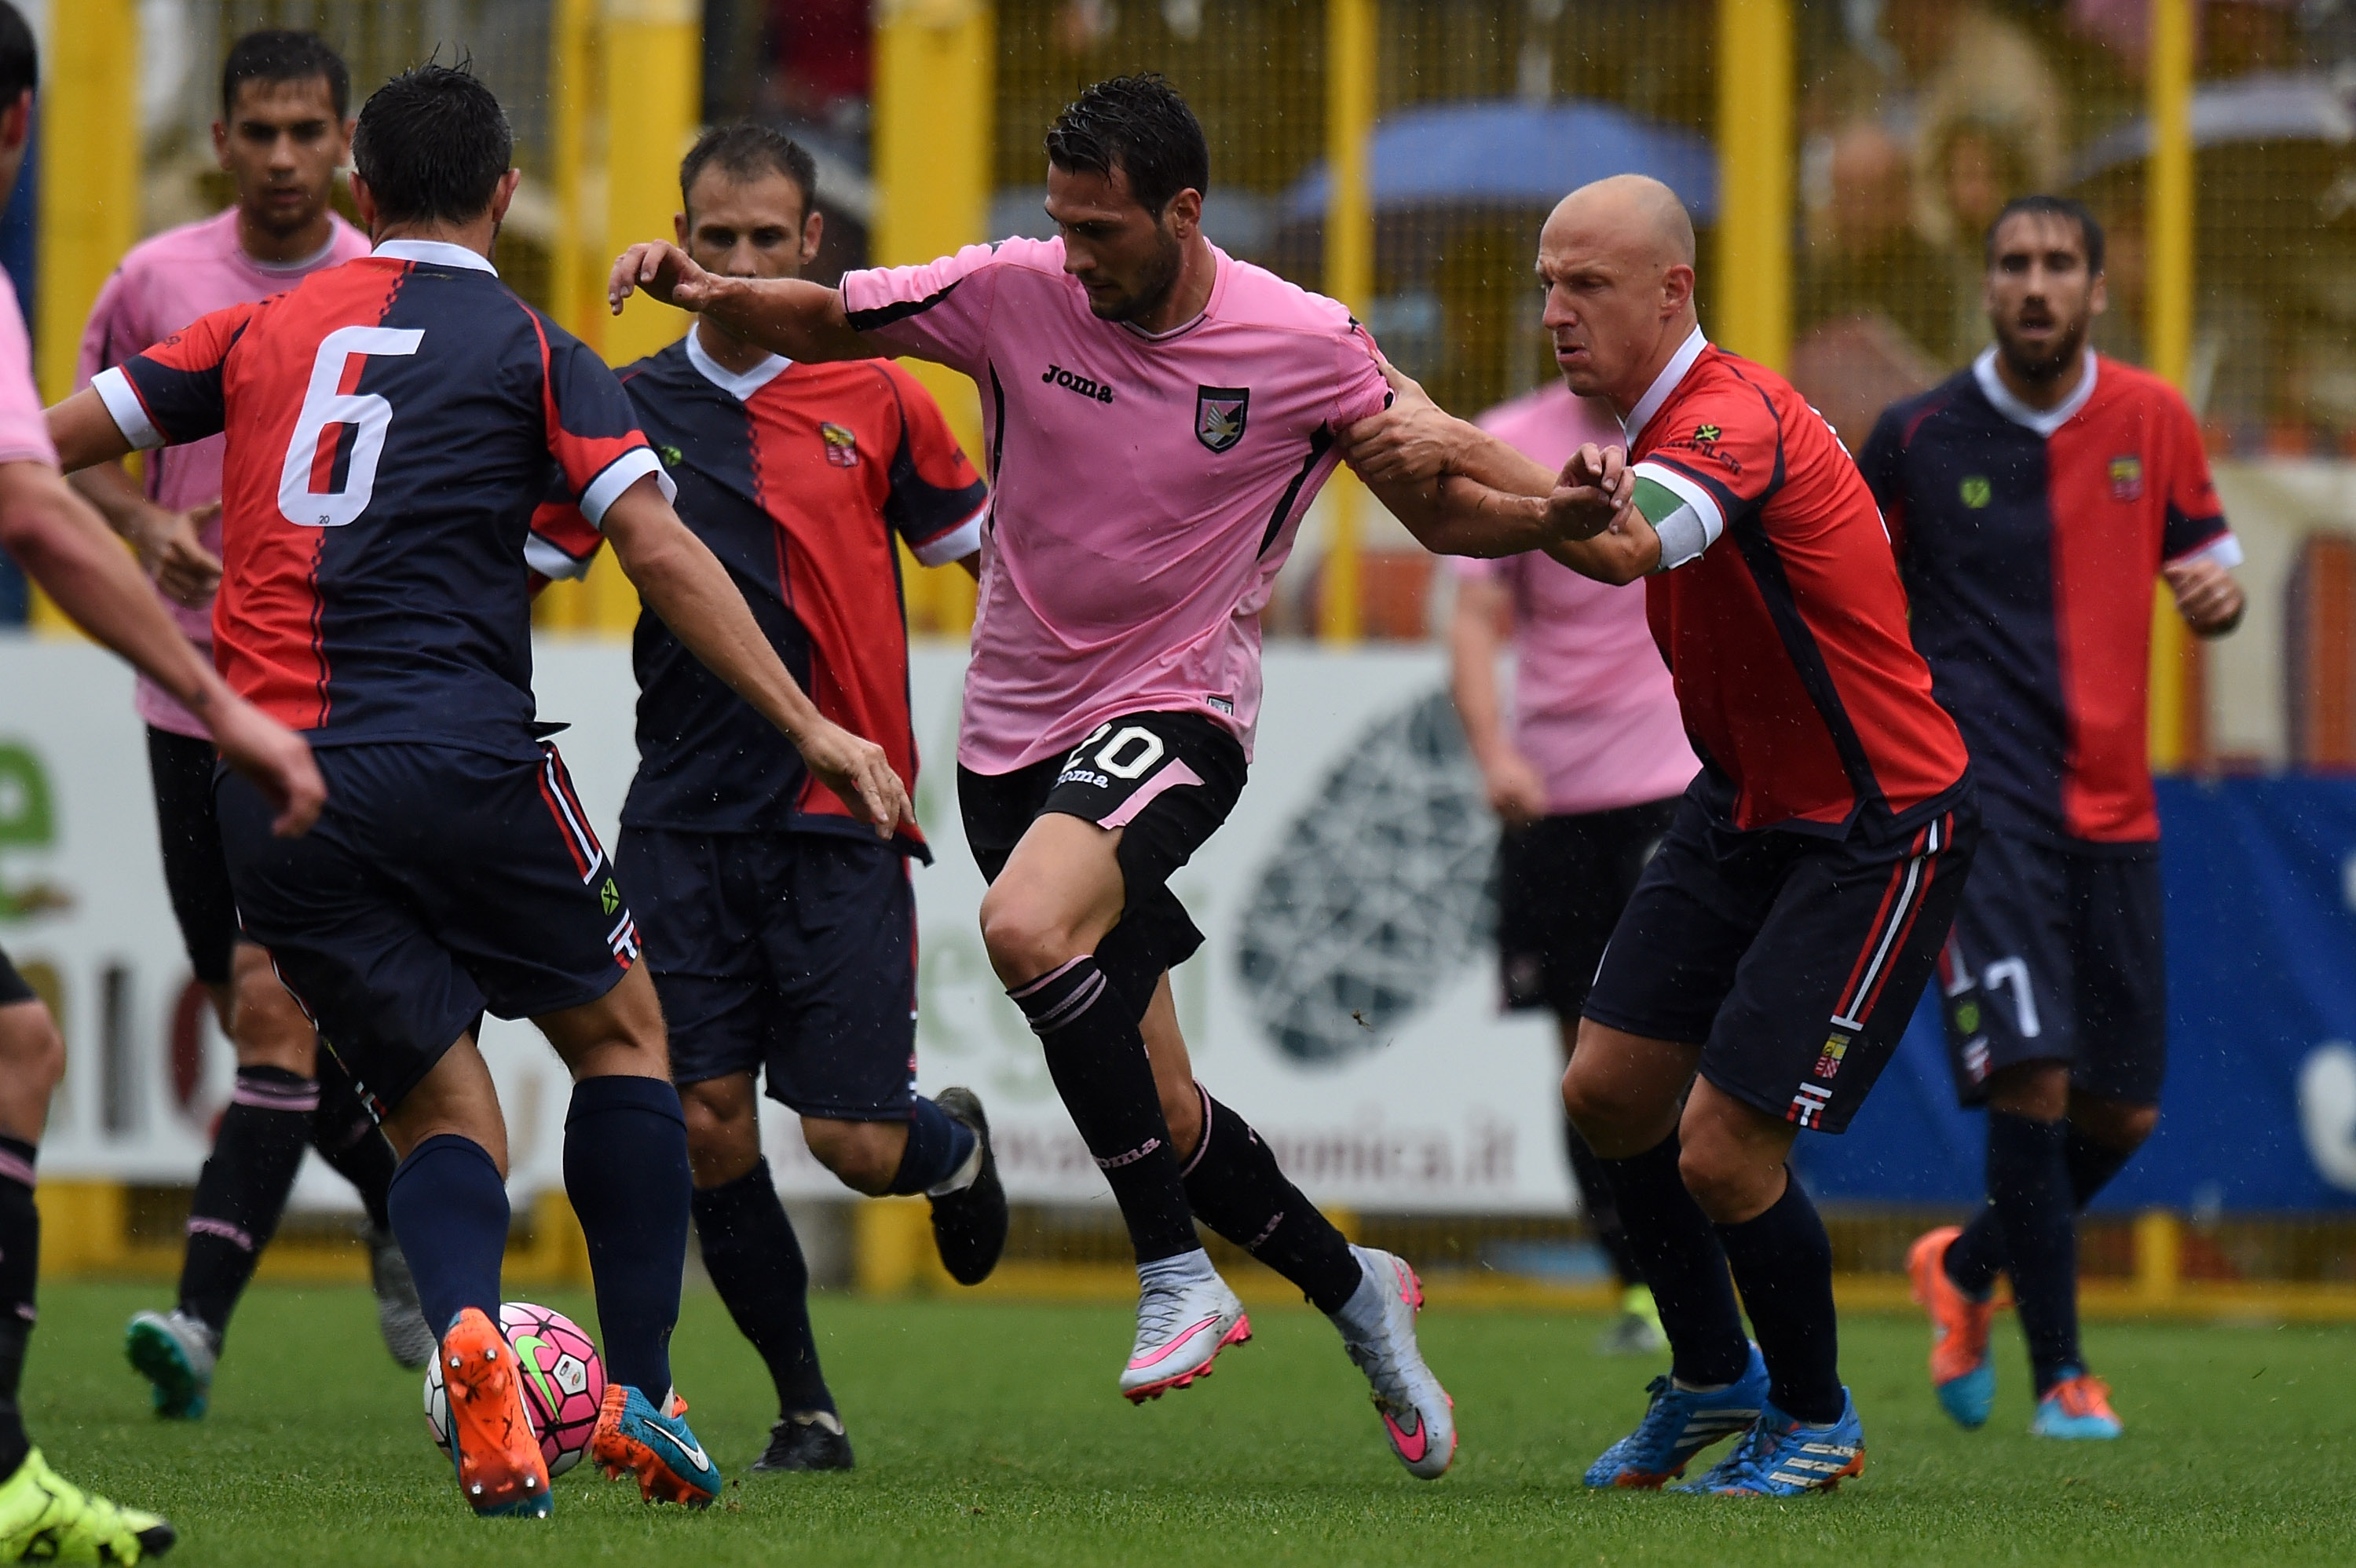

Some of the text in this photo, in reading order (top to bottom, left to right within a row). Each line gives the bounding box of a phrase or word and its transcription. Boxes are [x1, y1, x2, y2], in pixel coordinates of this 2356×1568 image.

[1041, 364, 1114, 404] Joma
[276, 325, 426, 527] 6
[319, 515, 331, 524] 20
[1060, 722, 1165, 780] 20
[1983, 956, 2042, 1038] 7
